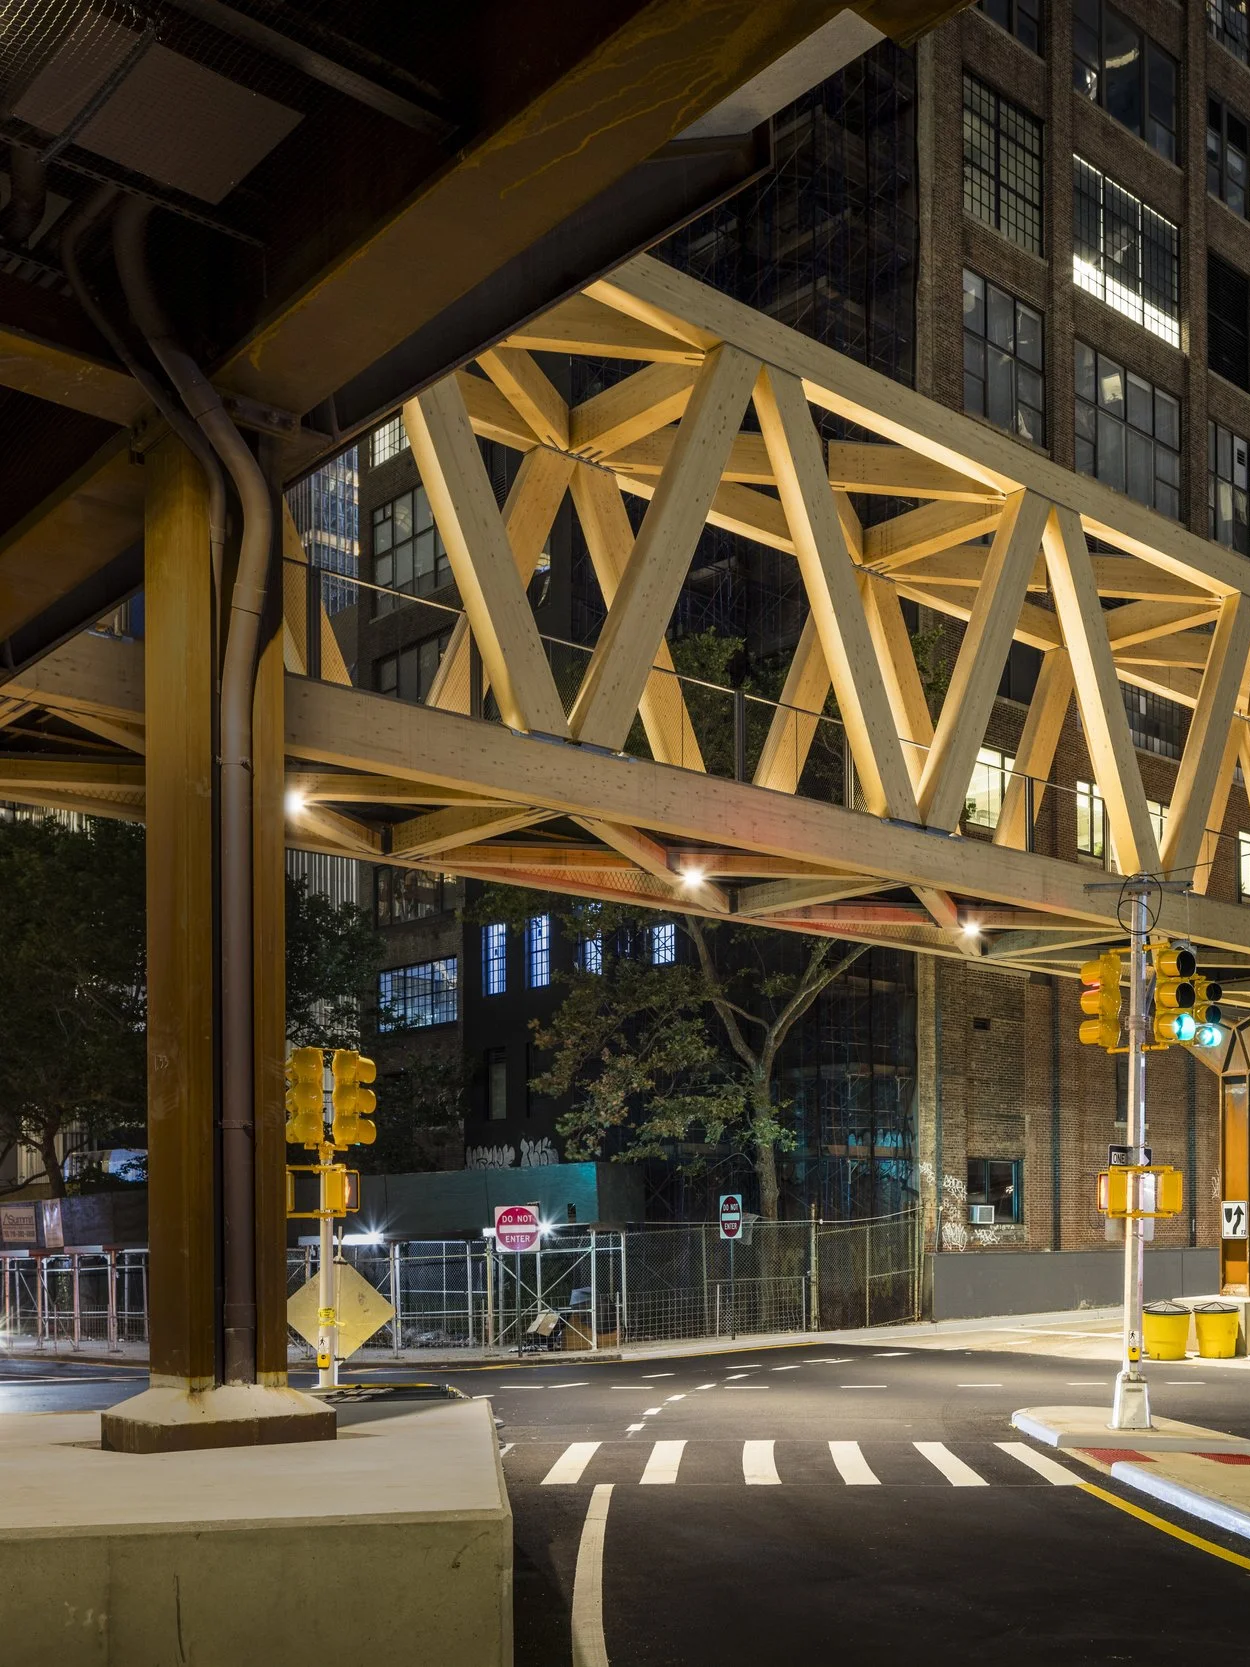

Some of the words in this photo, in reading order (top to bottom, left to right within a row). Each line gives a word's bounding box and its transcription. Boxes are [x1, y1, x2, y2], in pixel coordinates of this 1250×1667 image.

[1113, 1153, 1125, 1164] ONE
[723, 1203, 730, 1211] DO
[730, 1203, 738, 1211] NOT
[502, 1215, 513, 1223] DO
[517, 1214, 532, 1223] NOT
[724, 1222, 737, 1230] ENTER
[505, 1235, 530, 1243] ENTER
